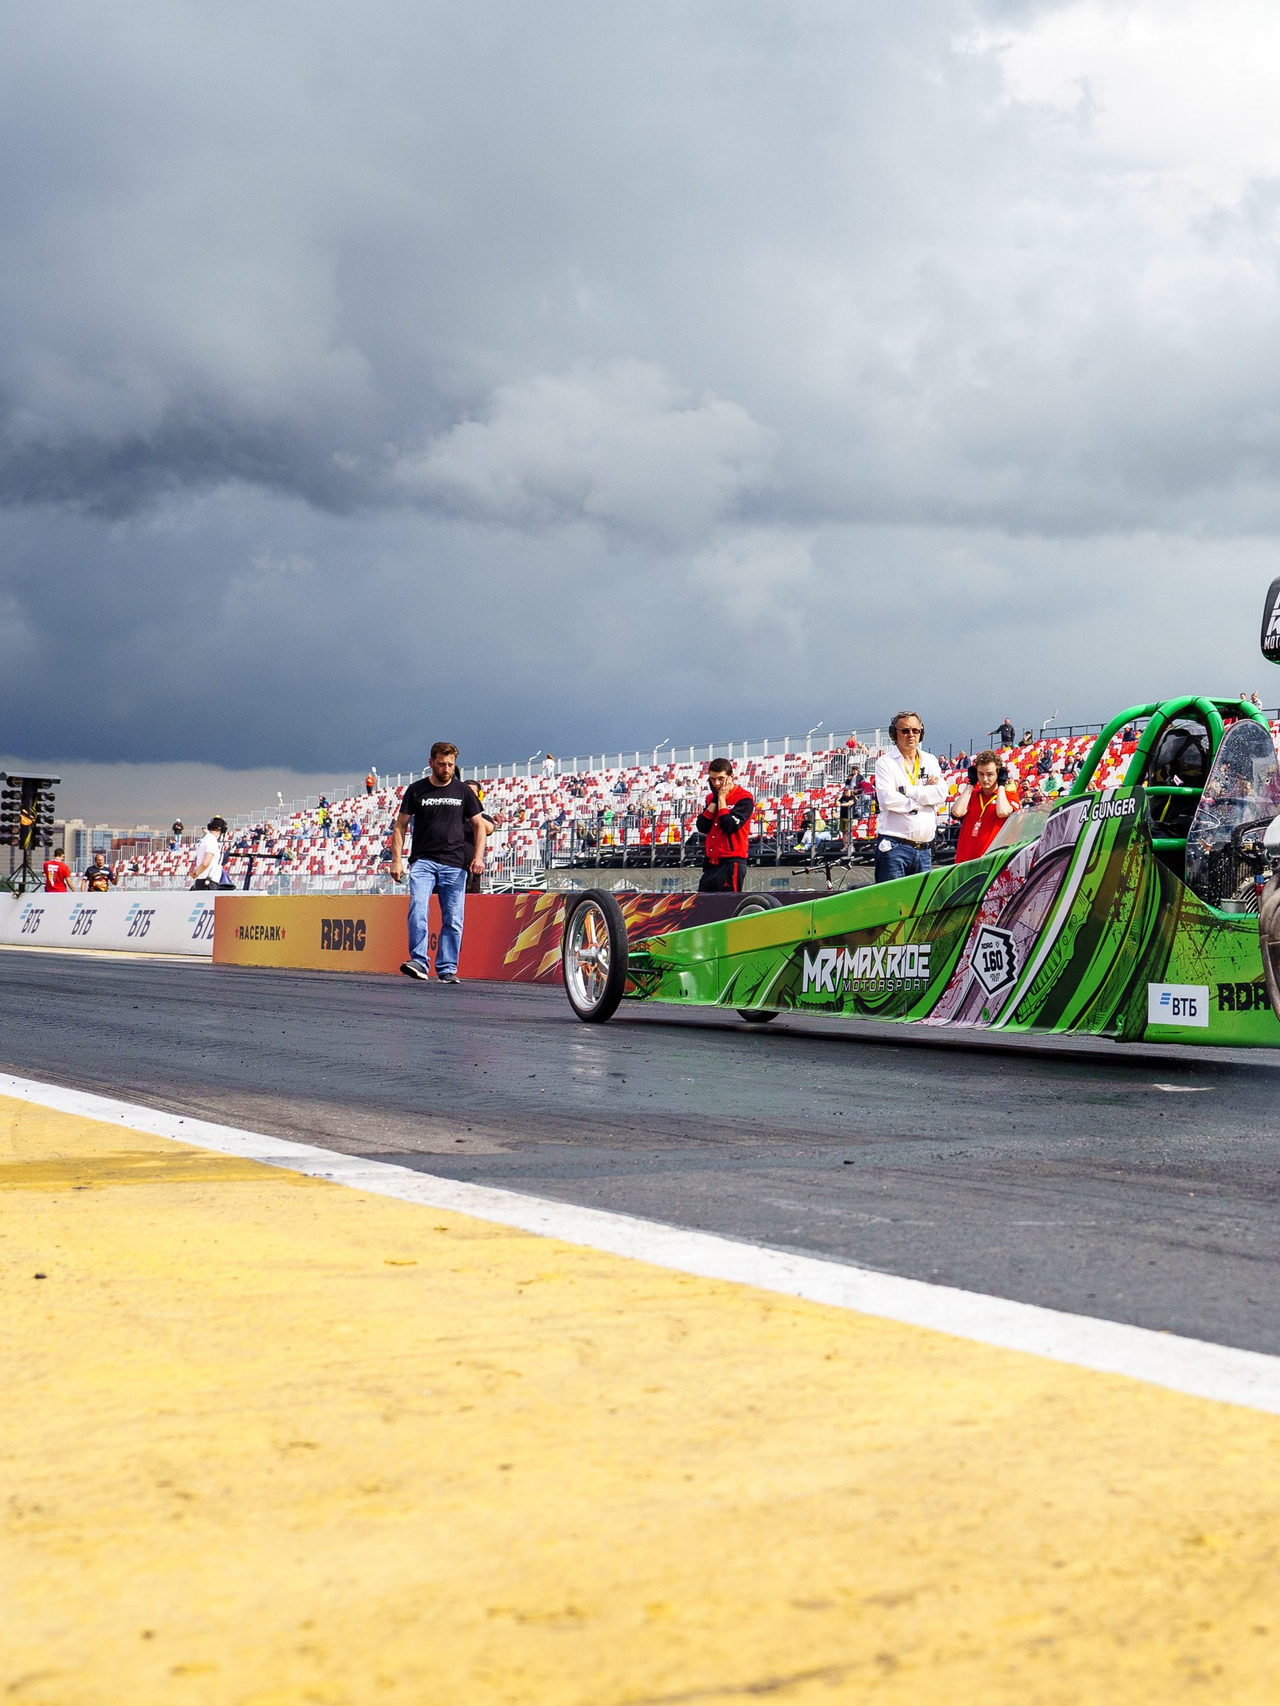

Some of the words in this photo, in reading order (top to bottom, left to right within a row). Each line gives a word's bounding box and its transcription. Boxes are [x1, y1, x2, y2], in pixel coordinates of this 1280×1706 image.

[1080, 805, 1090, 822] A.
[1091, 798, 1136, 821] GUNGER
[21, 909, 45, 933] ВТБ
[71, 909, 97, 935] ВТБ
[127, 909, 155, 937] ВТБ
[239, 925, 281, 941] RACEPARK
[321, 919, 366, 951] RDRC
[982, 950, 1004, 972] 160
[841, 979, 930, 992] MOTORSPORT
[1217, 982, 1271, 1011] RDR
[1172, 997, 1197, 1017] ВТБ
